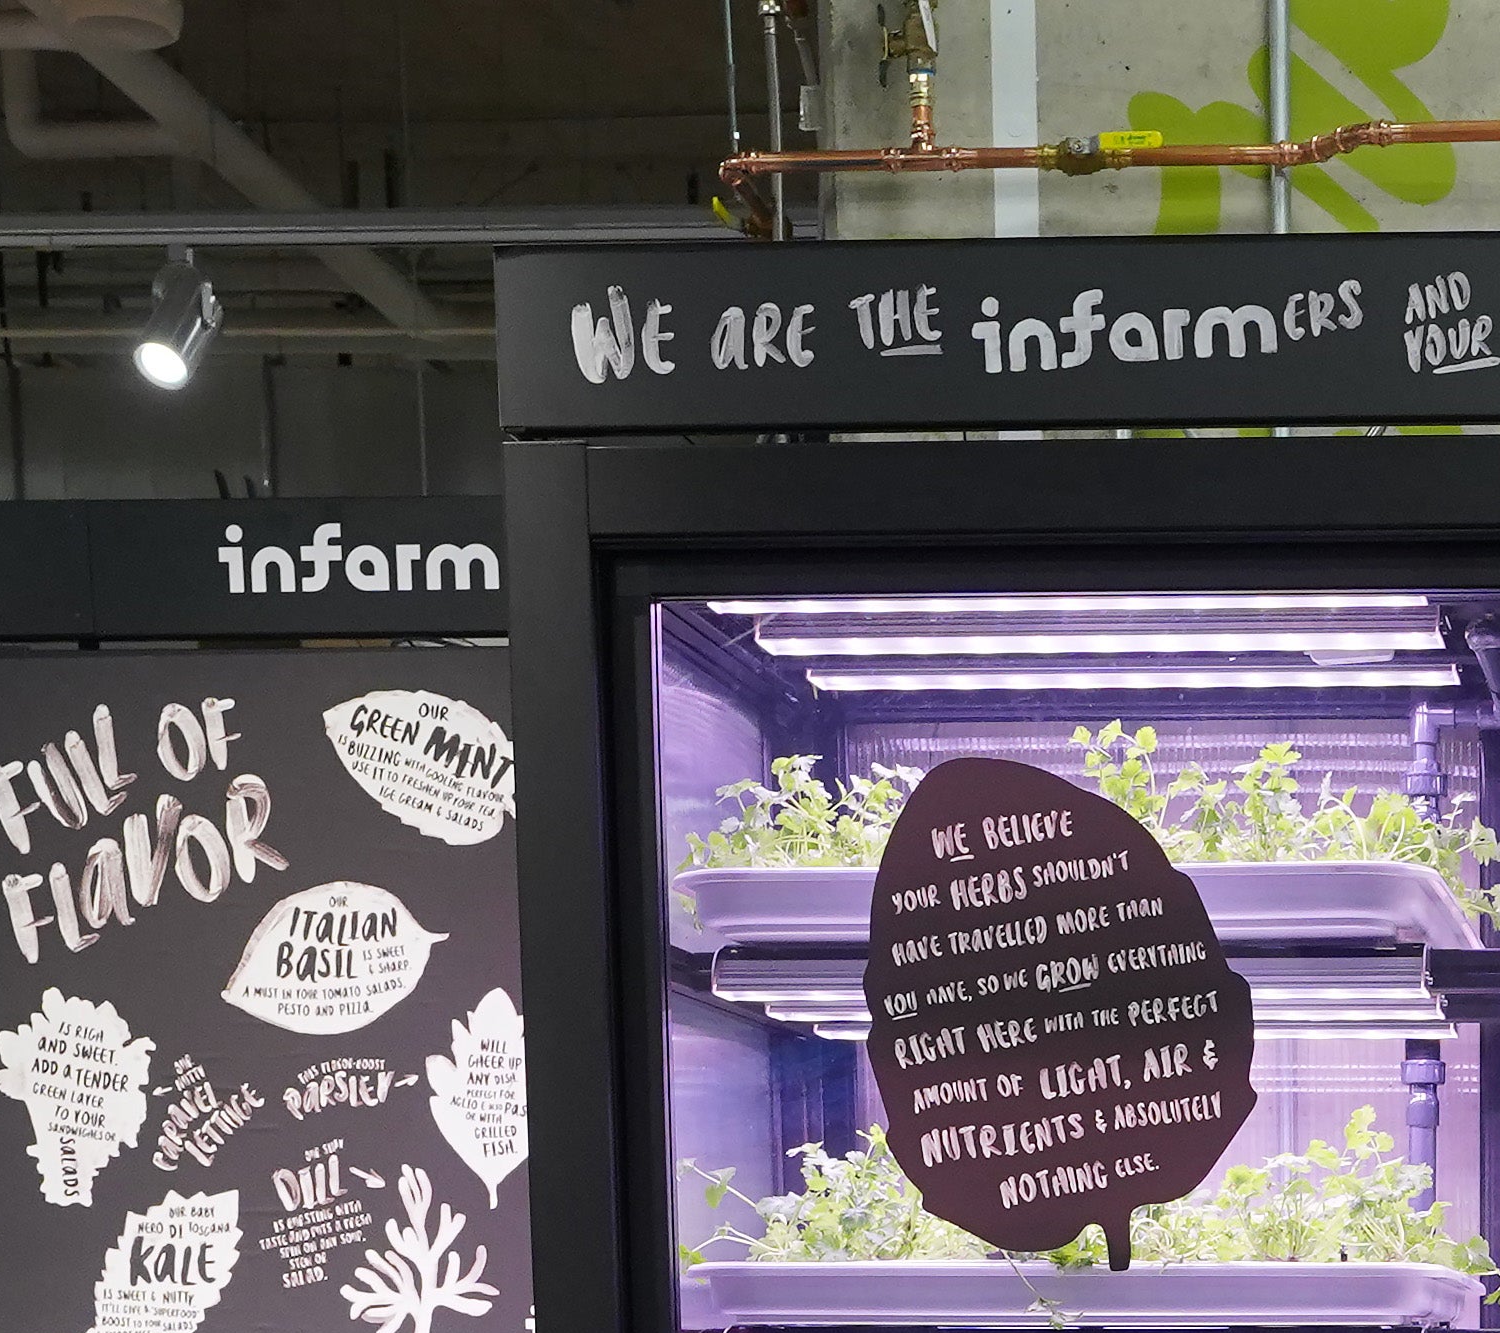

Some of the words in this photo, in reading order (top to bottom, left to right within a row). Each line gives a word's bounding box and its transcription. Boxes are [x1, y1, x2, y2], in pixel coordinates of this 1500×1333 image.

[218, 523, 499, 593] infarm
[350, 704, 420, 745] GREEN
[423, 727, 514, 789] MINT
